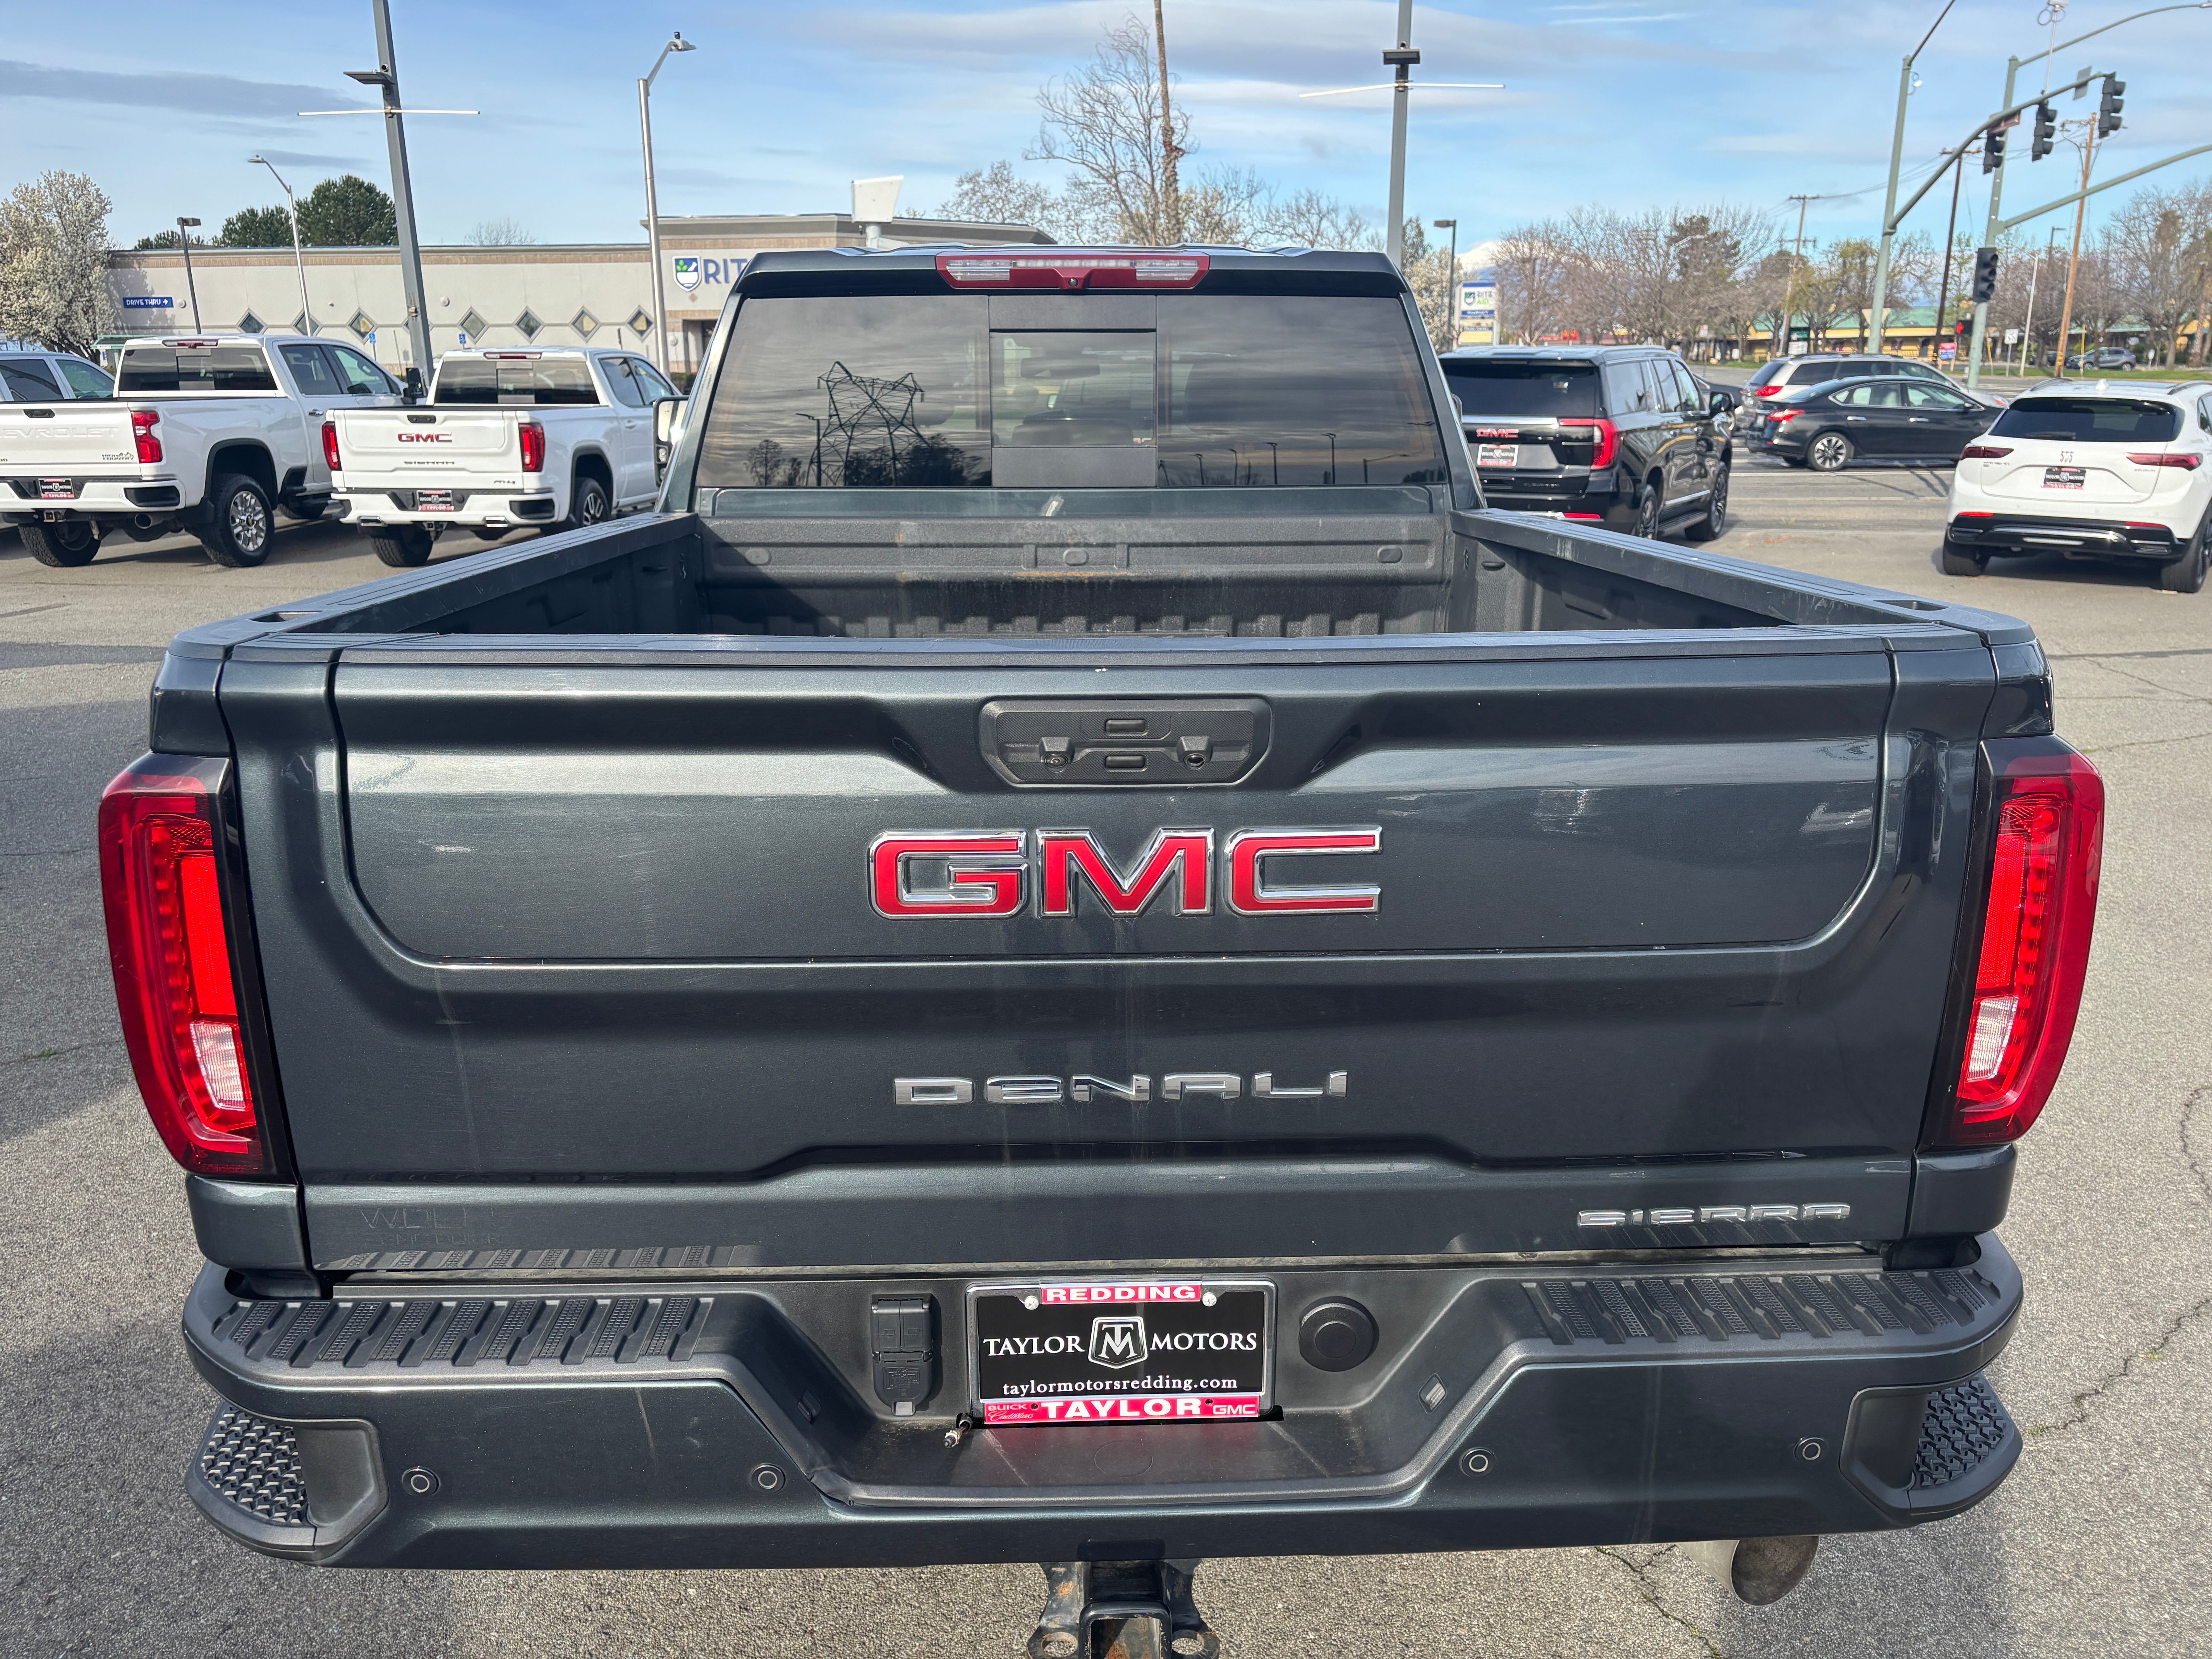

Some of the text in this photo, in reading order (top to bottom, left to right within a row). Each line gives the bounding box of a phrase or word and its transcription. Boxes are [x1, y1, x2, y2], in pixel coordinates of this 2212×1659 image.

[703, 258, 748, 284] RIT
[0, 427, 119, 438] EVROLET
[398, 432, 452, 443] GMC
[1476, 428, 1519, 438] GMC
[869, 826, 1382, 919] GMC
[894, 1072, 1348, 1105] DENALI
[1578, 1203, 1851, 1228] SIERRA
[1046, 1286, 1196, 1302] REDDING
[984, 1333, 1257, 1357] TAYLOR MOTORS
[1003, 1376, 1238, 1397] taylormotorsredding.com
[988, 1410, 1034, 1421] Cadillac
[1041, 1398, 1201, 1419] TAYLOR
[1212, 1404, 1256, 1415] GMC
